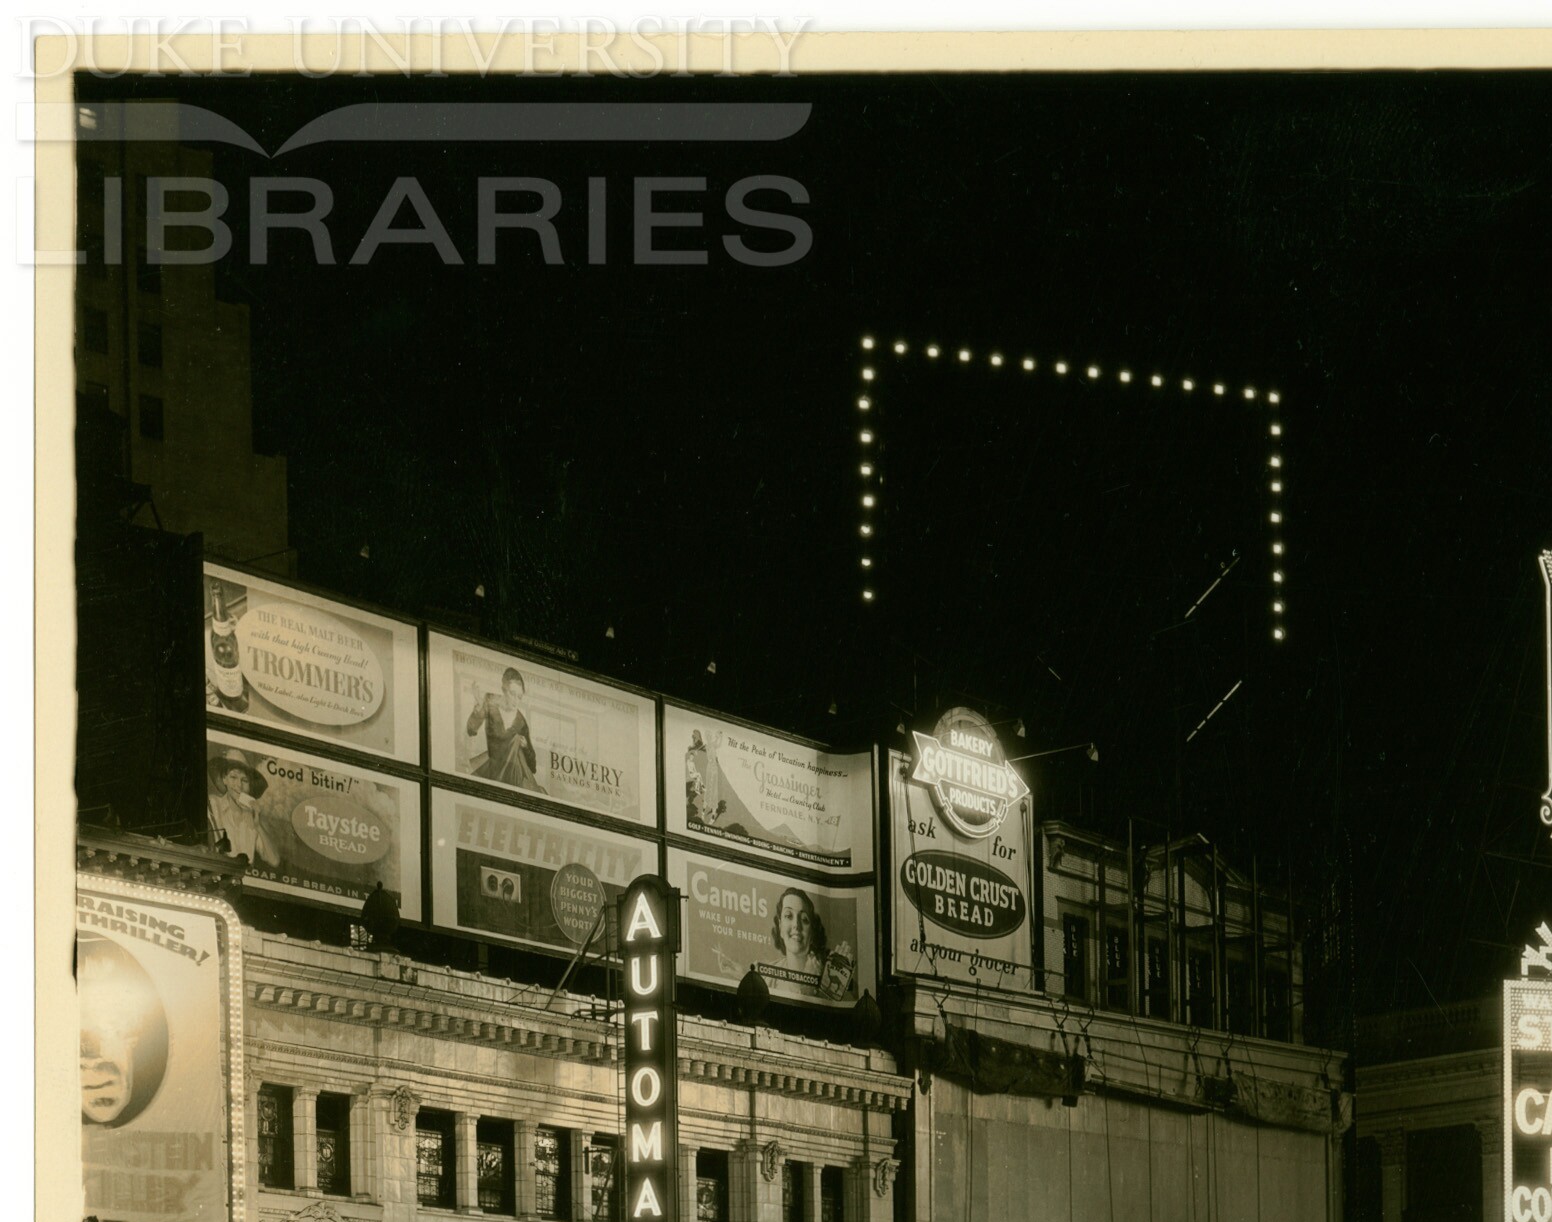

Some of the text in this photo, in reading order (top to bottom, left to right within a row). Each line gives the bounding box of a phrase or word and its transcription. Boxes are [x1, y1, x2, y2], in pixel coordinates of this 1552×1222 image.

[257, 610, 364, 651] THE REAL MALT BEER
[272, 633, 289, 647] that
[291, 639, 310, 653] high
[247, 646, 374, 704] TROMMER'S
[727, 737, 806, 769] Hit the Peak of Vacation
[950, 729, 993, 757] BAKERY
[550, 750, 624, 787] BOWERY
[754, 761, 822, 800] Grossinger
[922, 747, 1018, 799] GOTTFRIED'S
[550, 772, 622, 797] SAVINGS BANK
[765, 788, 781, 801] Hotel
[812, 801, 826, 812] Club
[949, 788, 996, 816] PRODUCTS
[304, 805, 381, 841] Taystee
[908, 817, 937, 839] ask
[319, 835, 367, 854] BREAD
[992, 836, 1016, 861] for
[283, 874, 298, 885] OF
[303, 880, 342, 895] BREAD
[347, 889, 359, 898] IN
[565, 873, 594, 889] YOUR
[905, 859, 1019, 911] GOLDEN CRUST
[560, 887, 598, 903] BIGGEST
[691, 871, 769, 918] Camels
[560, 901, 598, 918] PENNY'S
[699, 910, 736, 925] WAKE UP
[934, 894, 994, 928] BREAD
[712, 924, 772, 945] YOUR ENERGY!
[759, 966, 819, 985] COSTLIER TOBACCOS
[968, 949, 1019, 976] grocer
